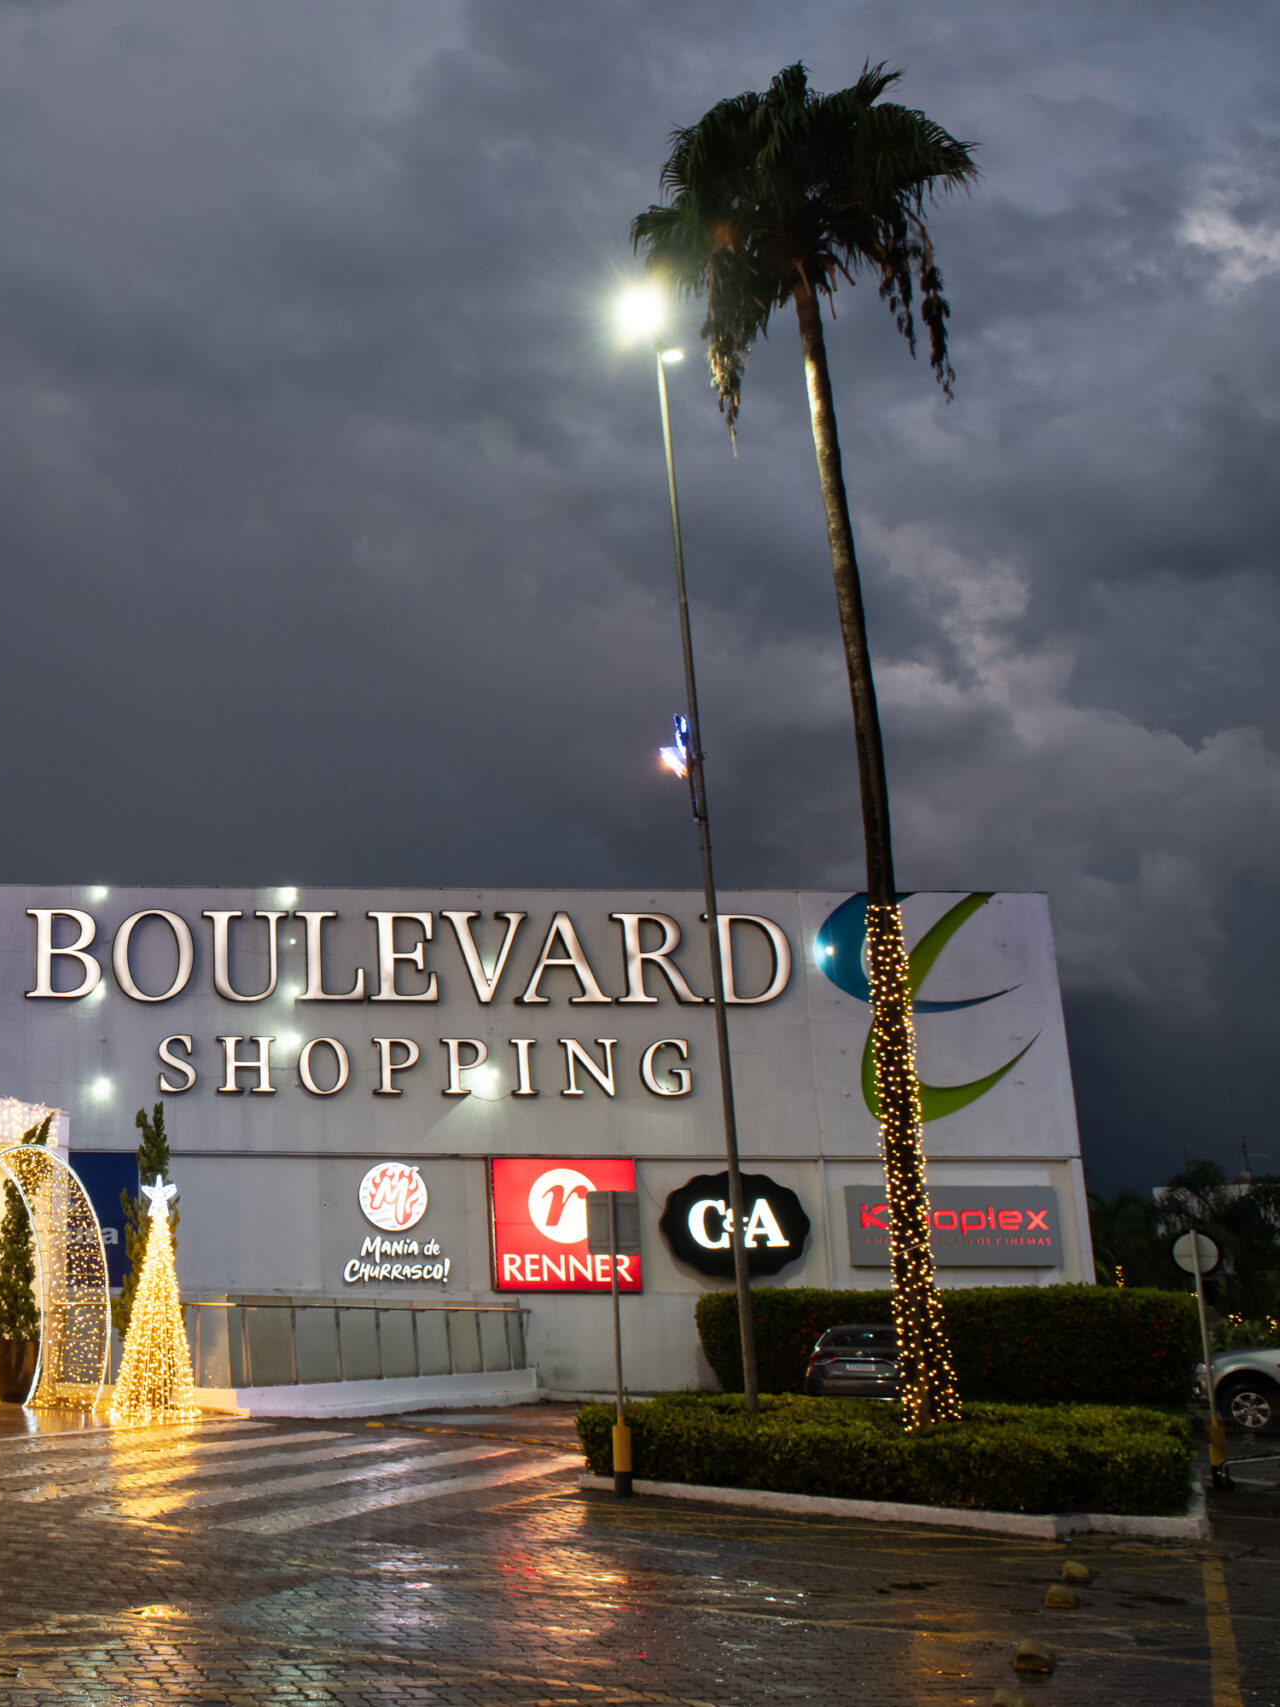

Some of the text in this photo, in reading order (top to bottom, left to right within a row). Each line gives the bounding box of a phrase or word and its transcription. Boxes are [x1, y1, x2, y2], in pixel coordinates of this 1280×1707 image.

[24, 907, 792, 1004] BOULEVARD
[158, 1034, 692, 1097] SHOPPING
[687, 1198, 790, 1249] C&A
[995, 1237, 1052, 1247] CINEMAS
[423, 1238, 441, 1256] de
[503, 1253, 634, 1282] RENNER
